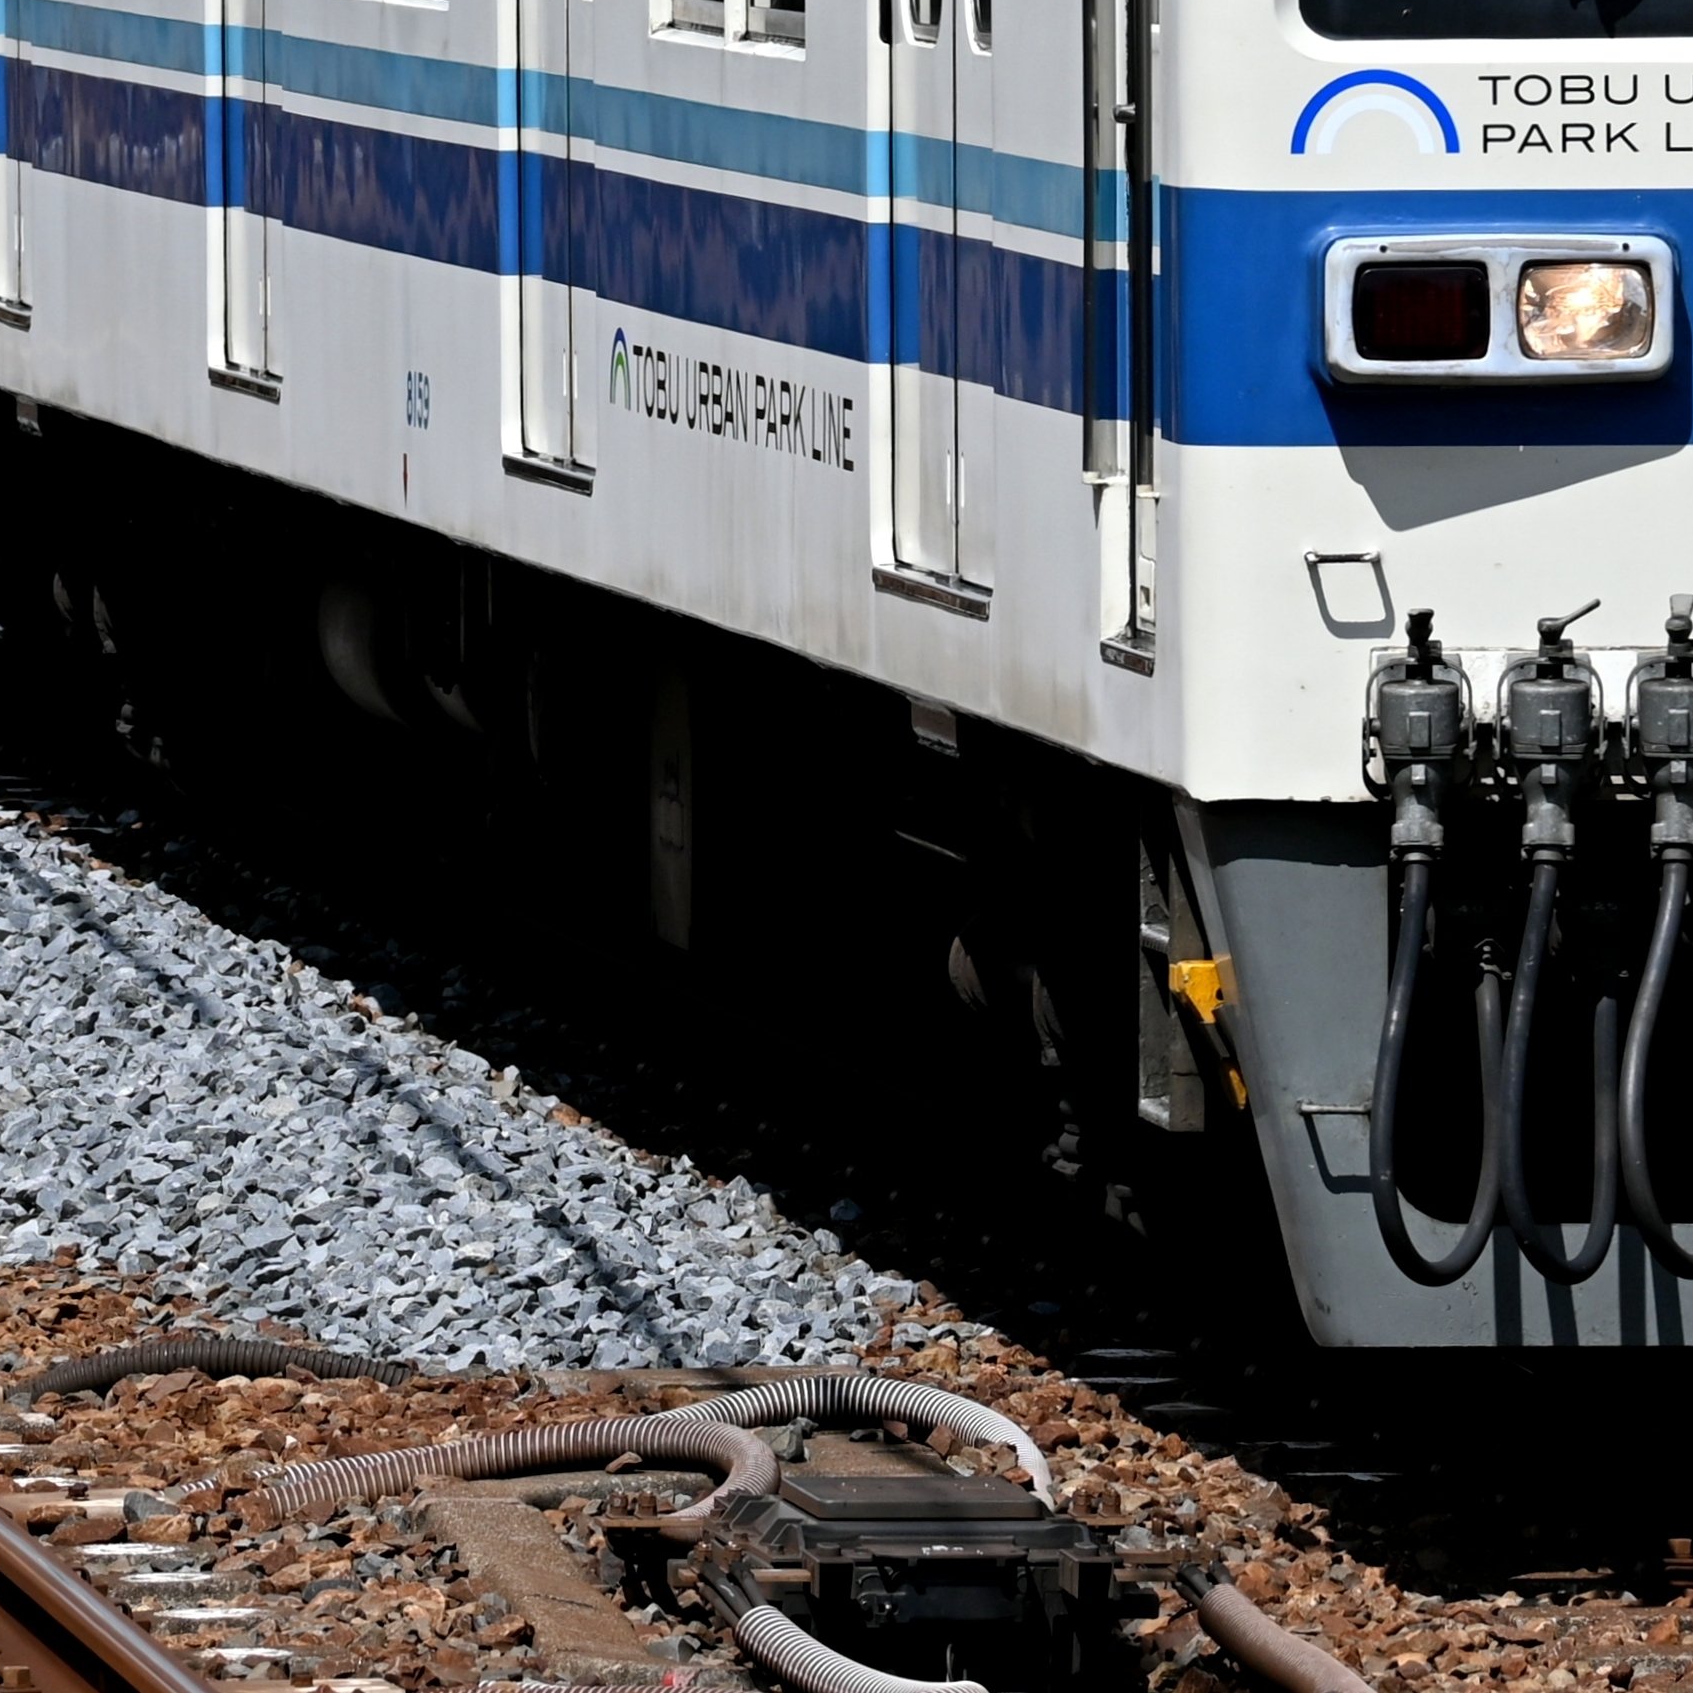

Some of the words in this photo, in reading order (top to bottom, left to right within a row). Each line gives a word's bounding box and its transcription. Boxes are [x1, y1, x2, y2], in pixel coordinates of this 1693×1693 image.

[1478, 74, 1639, 106] TOBU
[1482, 122, 1640, 153] PARK
[407, 370, 430, 430] 8159
[632, 345, 680, 425] TOBU
[685, 359, 749, 442] URBAN
[755, 374, 807, 458] PARK
[812, 387, 855, 472] LINE
